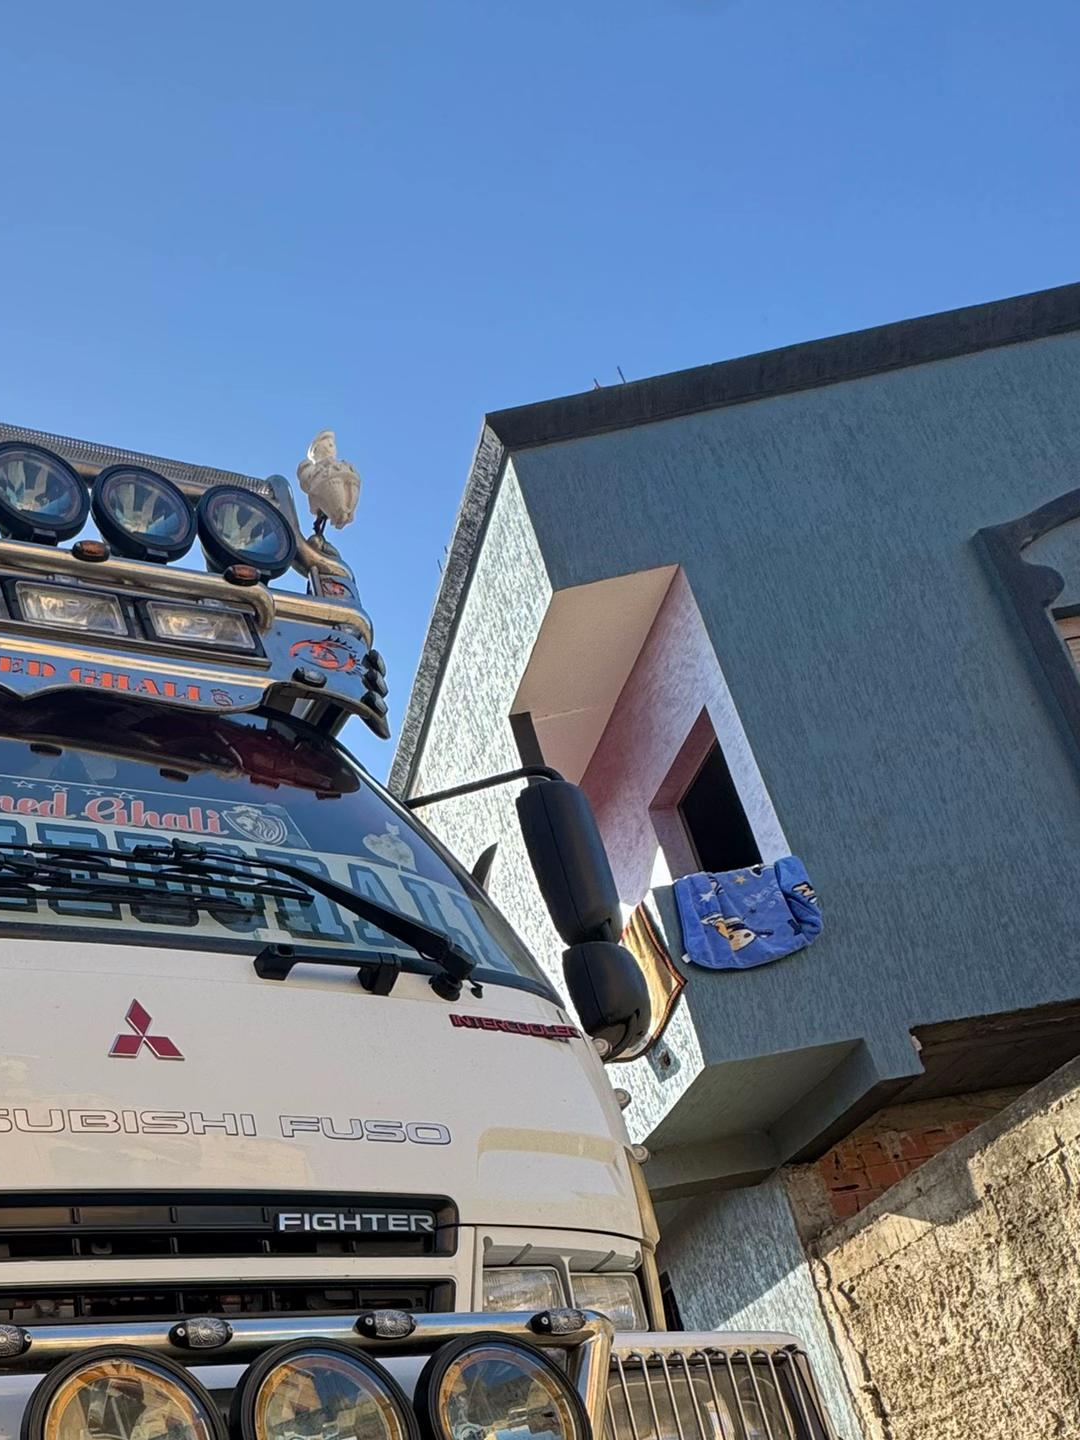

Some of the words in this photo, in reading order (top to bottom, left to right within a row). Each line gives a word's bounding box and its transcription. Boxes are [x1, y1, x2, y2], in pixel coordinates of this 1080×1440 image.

[69, 667, 201, 701] GHALI
[82, 795, 228, 835] Ghali
[449, 1014, 580, 1040] INTERCOOLER
[280, 1115, 452, 1145] FUSO
[277, 1212, 435, 1234] FIGHTER
